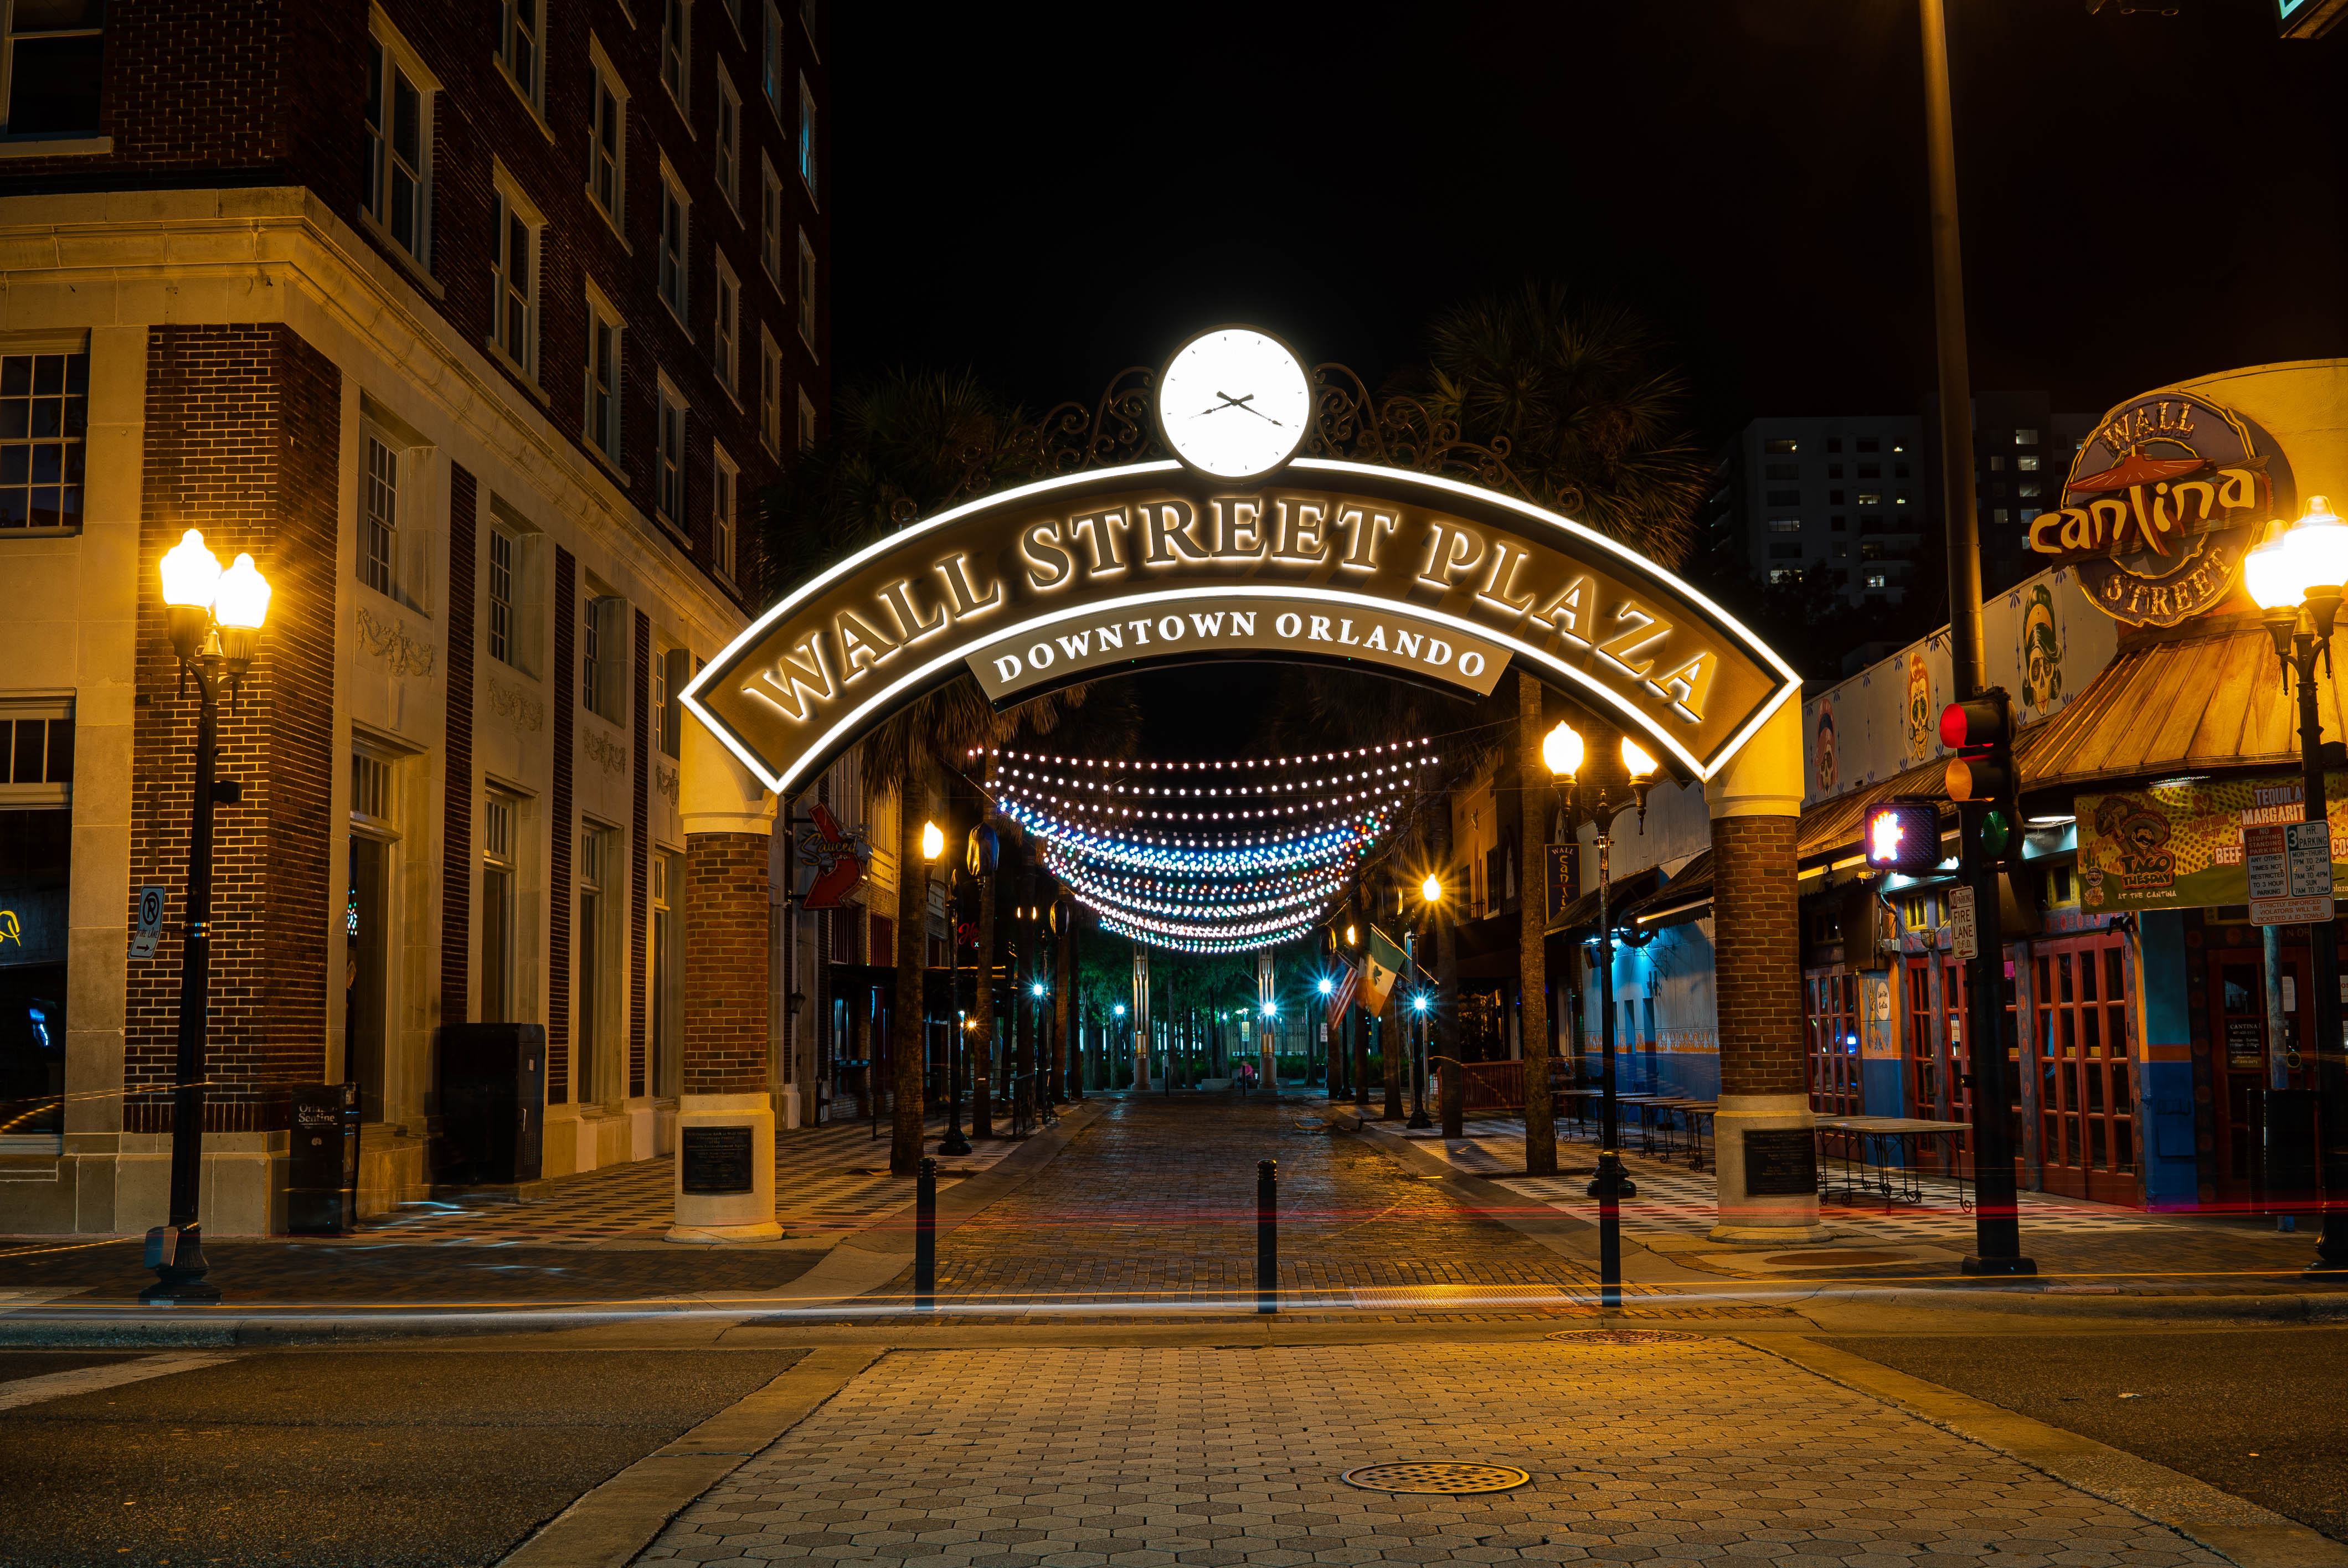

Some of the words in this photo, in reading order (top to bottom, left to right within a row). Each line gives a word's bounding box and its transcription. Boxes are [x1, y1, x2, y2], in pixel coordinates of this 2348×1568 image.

[2102, 401, 2195, 450] WALL
[2105, 546, 2232, 616] STREET
[741, 553, 1000, 718] WALL
[1023, 498, 1398, 587] STREET
[1419, 523, 1717, 720] PLAZA
[993, 612, 1257, 683] DOWNTOWN
[1275, 613, 1485, 677] ORLANDO
[2241, 804, 2305, 825] MARGARIT
[2248, 833, 2282, 842] STOPPING
[2248, 840, 2282, 848] STANDING
[2288, 830, 2298, 848] 3
[2299, 836, 2327, 847] PARKING
[801, 833, 857, 866] Sauced
[1551, 847, 1574, 855] WALL
[2215, 846, 2242, 864] BEEF
[2249, 847, 2283, 855] PARKING
[2292, 849, 2326, 858] MON-THURS
[2122, 855, 2171, 874] TACO
[1559, 855, 1569, 911] canti
[2123, 872, 2171, 886] TUESDAY
[1950, 893, 1956, 907] NO
[1956, 894, 1971, 904] PARKING
[1954, 909, 1971, 924] FIRE
[147, 926, 159, 938] LANE
[1953, 925, 1973, 940] LANE
[298, 1112, 337, 1122] Sentine
